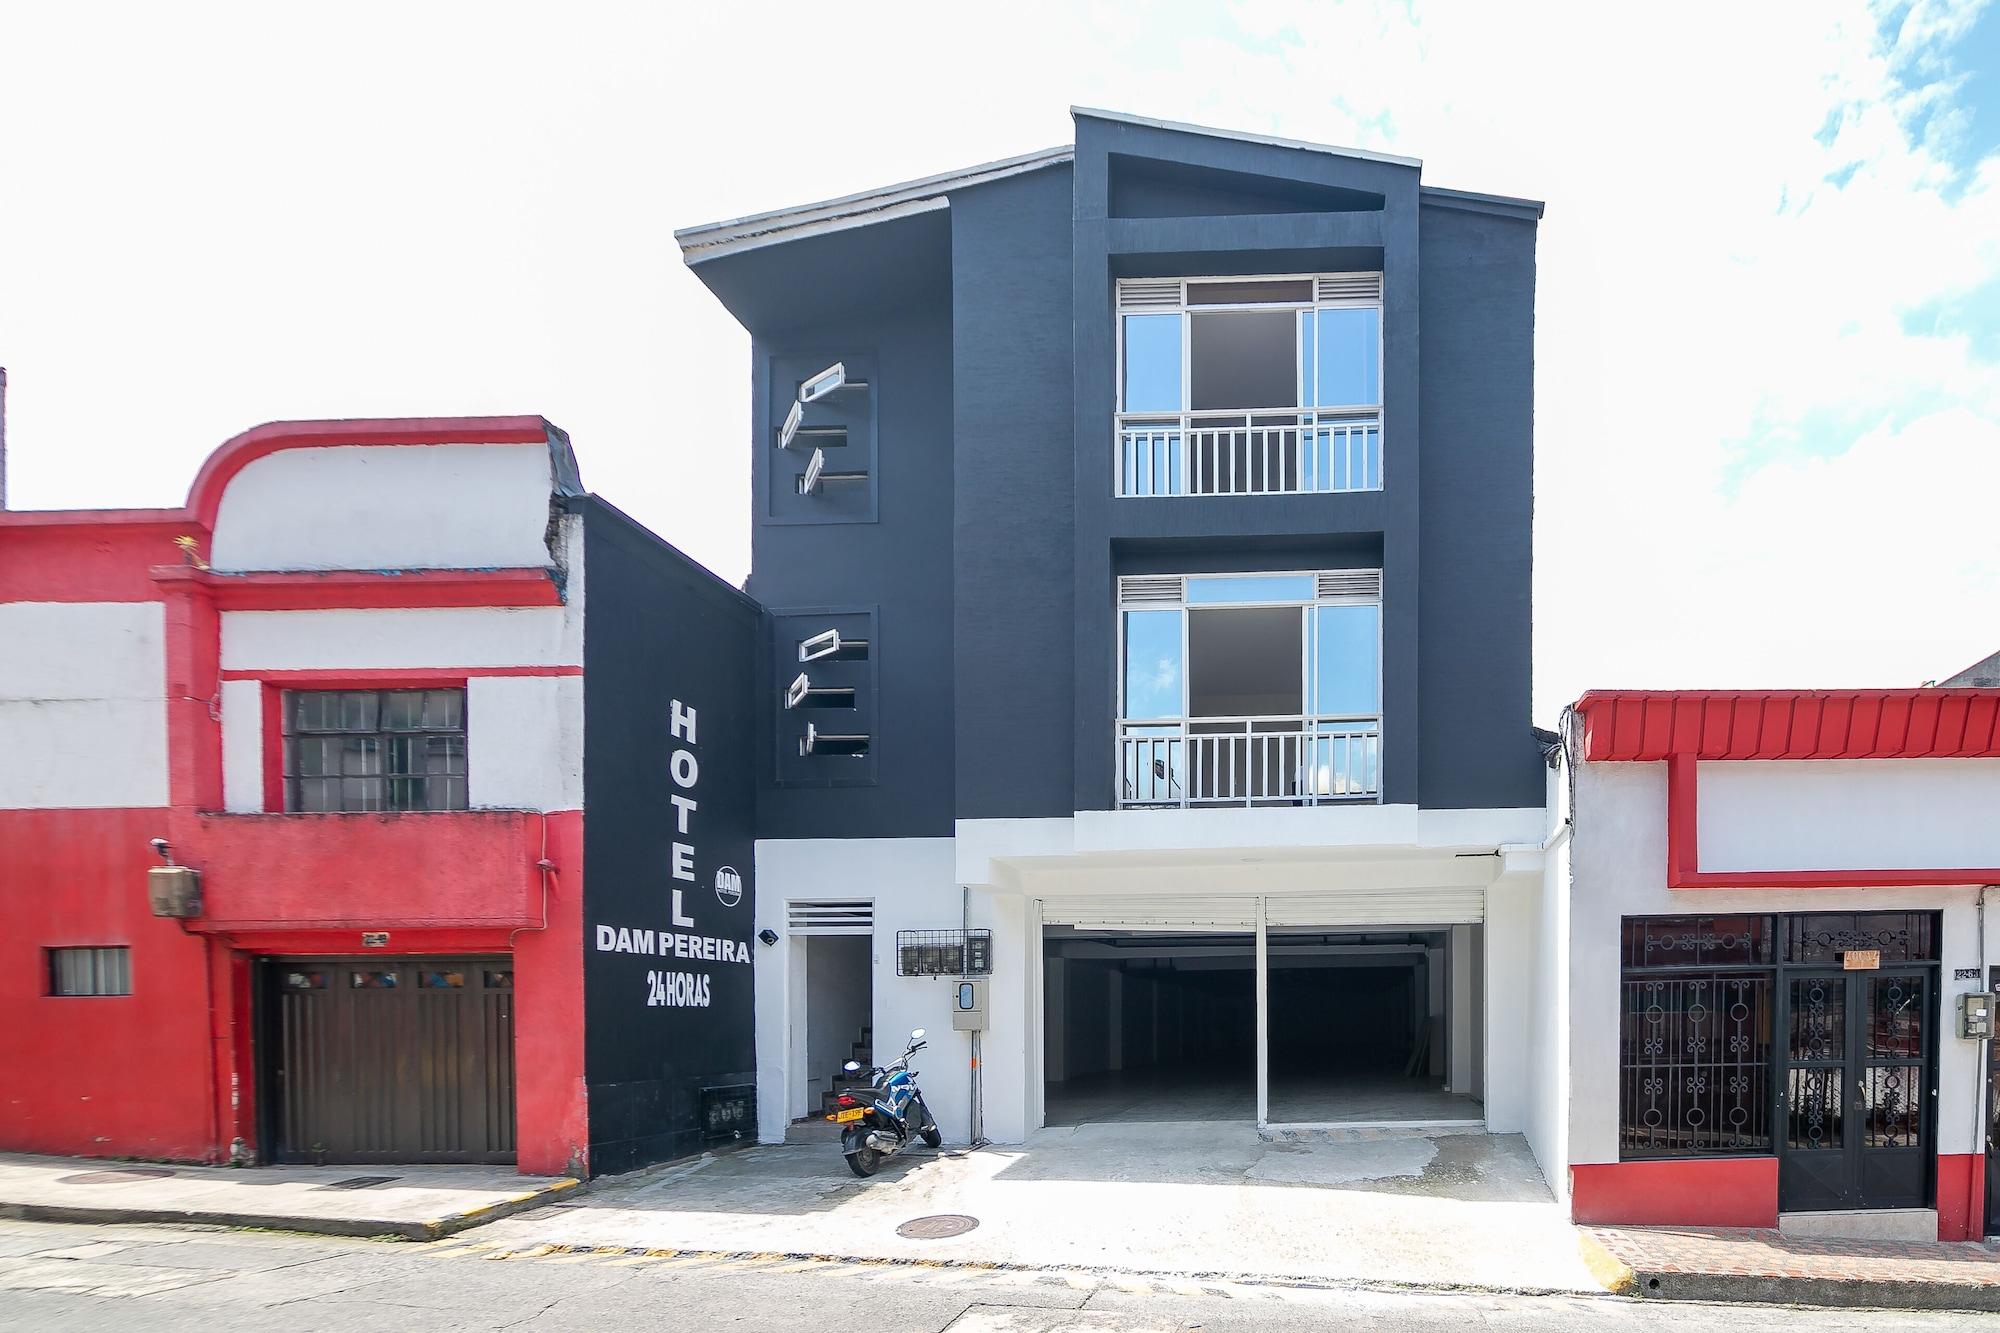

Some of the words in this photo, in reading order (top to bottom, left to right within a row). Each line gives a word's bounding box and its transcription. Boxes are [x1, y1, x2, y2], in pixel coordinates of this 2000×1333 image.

[670, 698, 699, 928] HOTEL
[716, 871, 741, 892] DAM
[596, 925, 655, 955] DAM
[659, 932, 751, 964] PEREIRA
